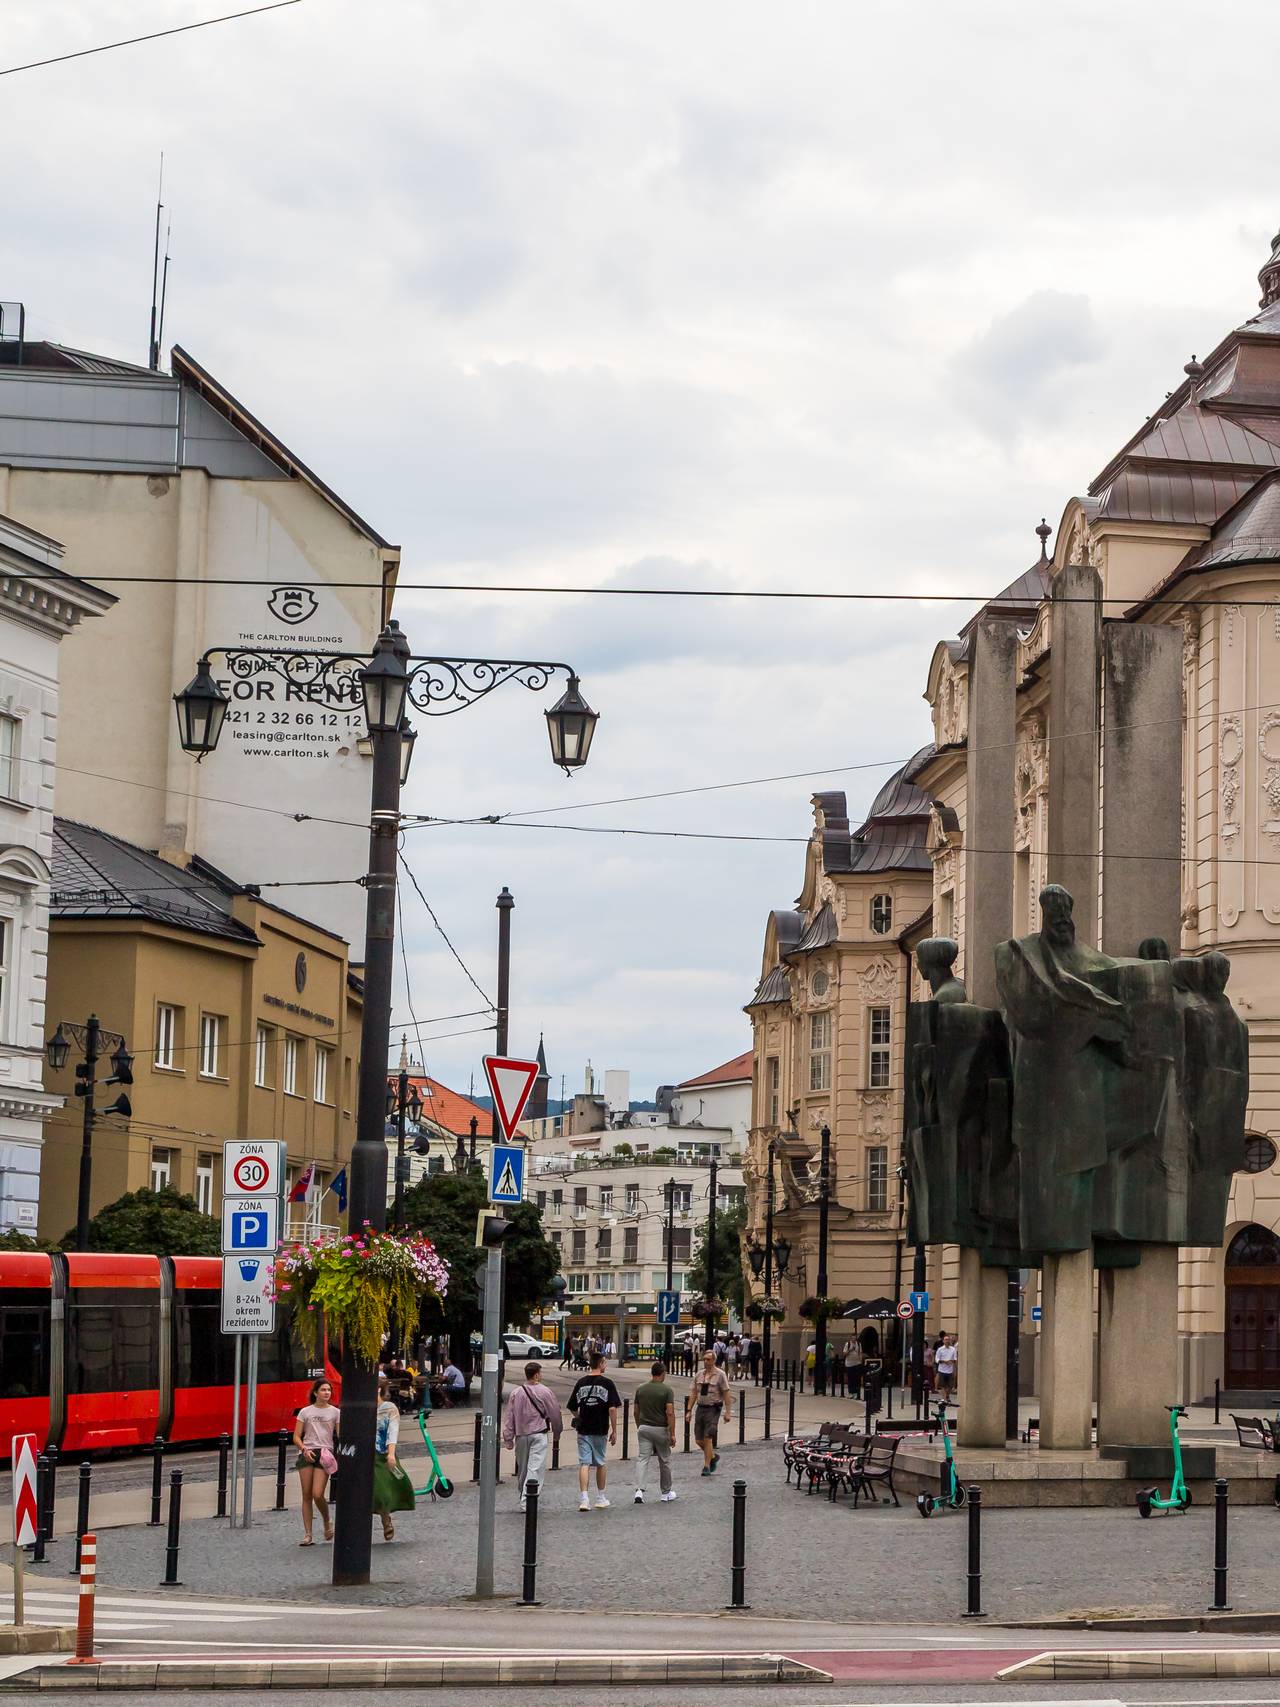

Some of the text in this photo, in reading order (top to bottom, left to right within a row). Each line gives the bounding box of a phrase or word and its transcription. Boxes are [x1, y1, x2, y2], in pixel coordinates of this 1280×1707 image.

[256, 634, 296, 642] CARLTON
[298, 635, 343, 644] BUILDINGS
[216, 679, 276, 702] FOR
[256, 712, 266, 724] 2
[271, 712, 290, 725] 32
[295, 713, 314, 725] 66
[320, 714, 338, 726] 12
[344, 715, 362, 727] 12
[232, 730, 341, 743] leasing@carlton.sk
[243, 748, 330, 758] www.carlton.sk
[239, 1144, 264, 1154] ZÓNA
[241, 1165, 262, 1182] 30
[238, 1200, 262, 1210] ZÓNA
[240, 1216, 260, 1244] P
[236, 1295, 261, 1304] 8-24h
[235, 1306, 261, 1315] okrem
[226, 1317, 269, 1327] rezidentov
